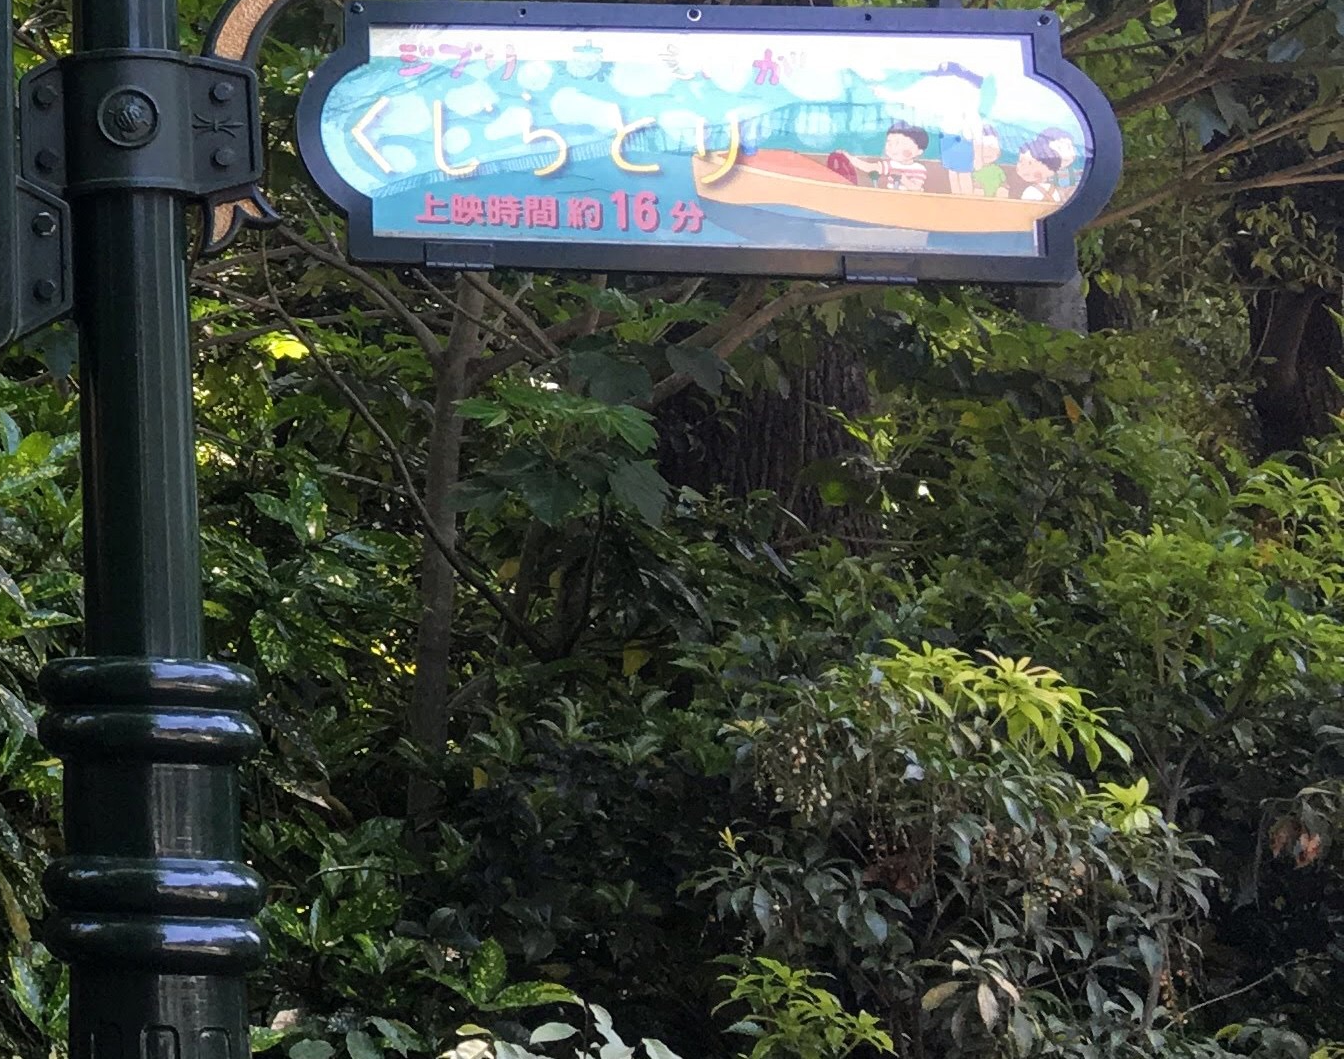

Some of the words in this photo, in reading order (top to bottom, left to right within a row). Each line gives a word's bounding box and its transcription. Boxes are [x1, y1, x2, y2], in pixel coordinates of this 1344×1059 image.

[348, 94, 742, 186] くじらとり
